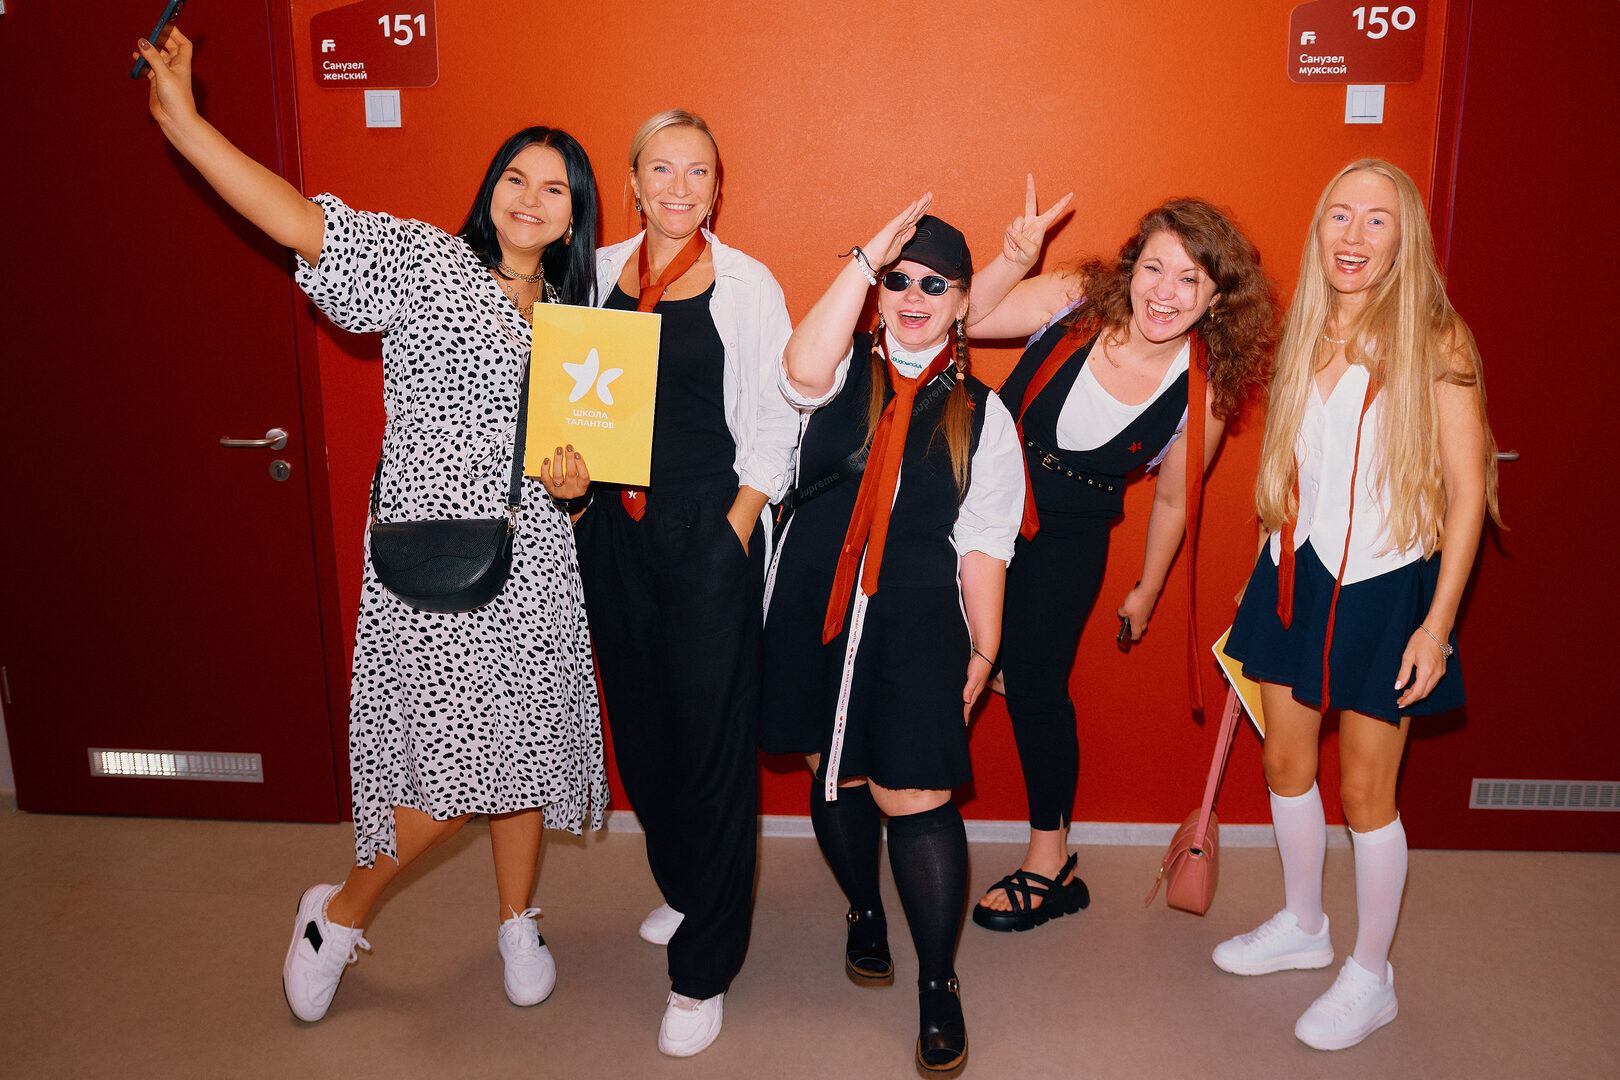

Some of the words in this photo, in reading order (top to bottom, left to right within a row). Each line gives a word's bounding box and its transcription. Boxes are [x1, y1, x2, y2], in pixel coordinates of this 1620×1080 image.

[1352, 5, 1416, 40] 150
[378, 14, 426, 46] 151
[1299, 53, 1345, 65] Санузел
[322, 60, 365, 72] Санузел
[1299, 64, 1347, 77] мужской
[323, 70, 368, 80] женский
[573, 409, 608, 419] ШКОЛА
[566, 418, 614, 429] ТАЛАНТОВ
[800, 471, 841, 498] Supreme
